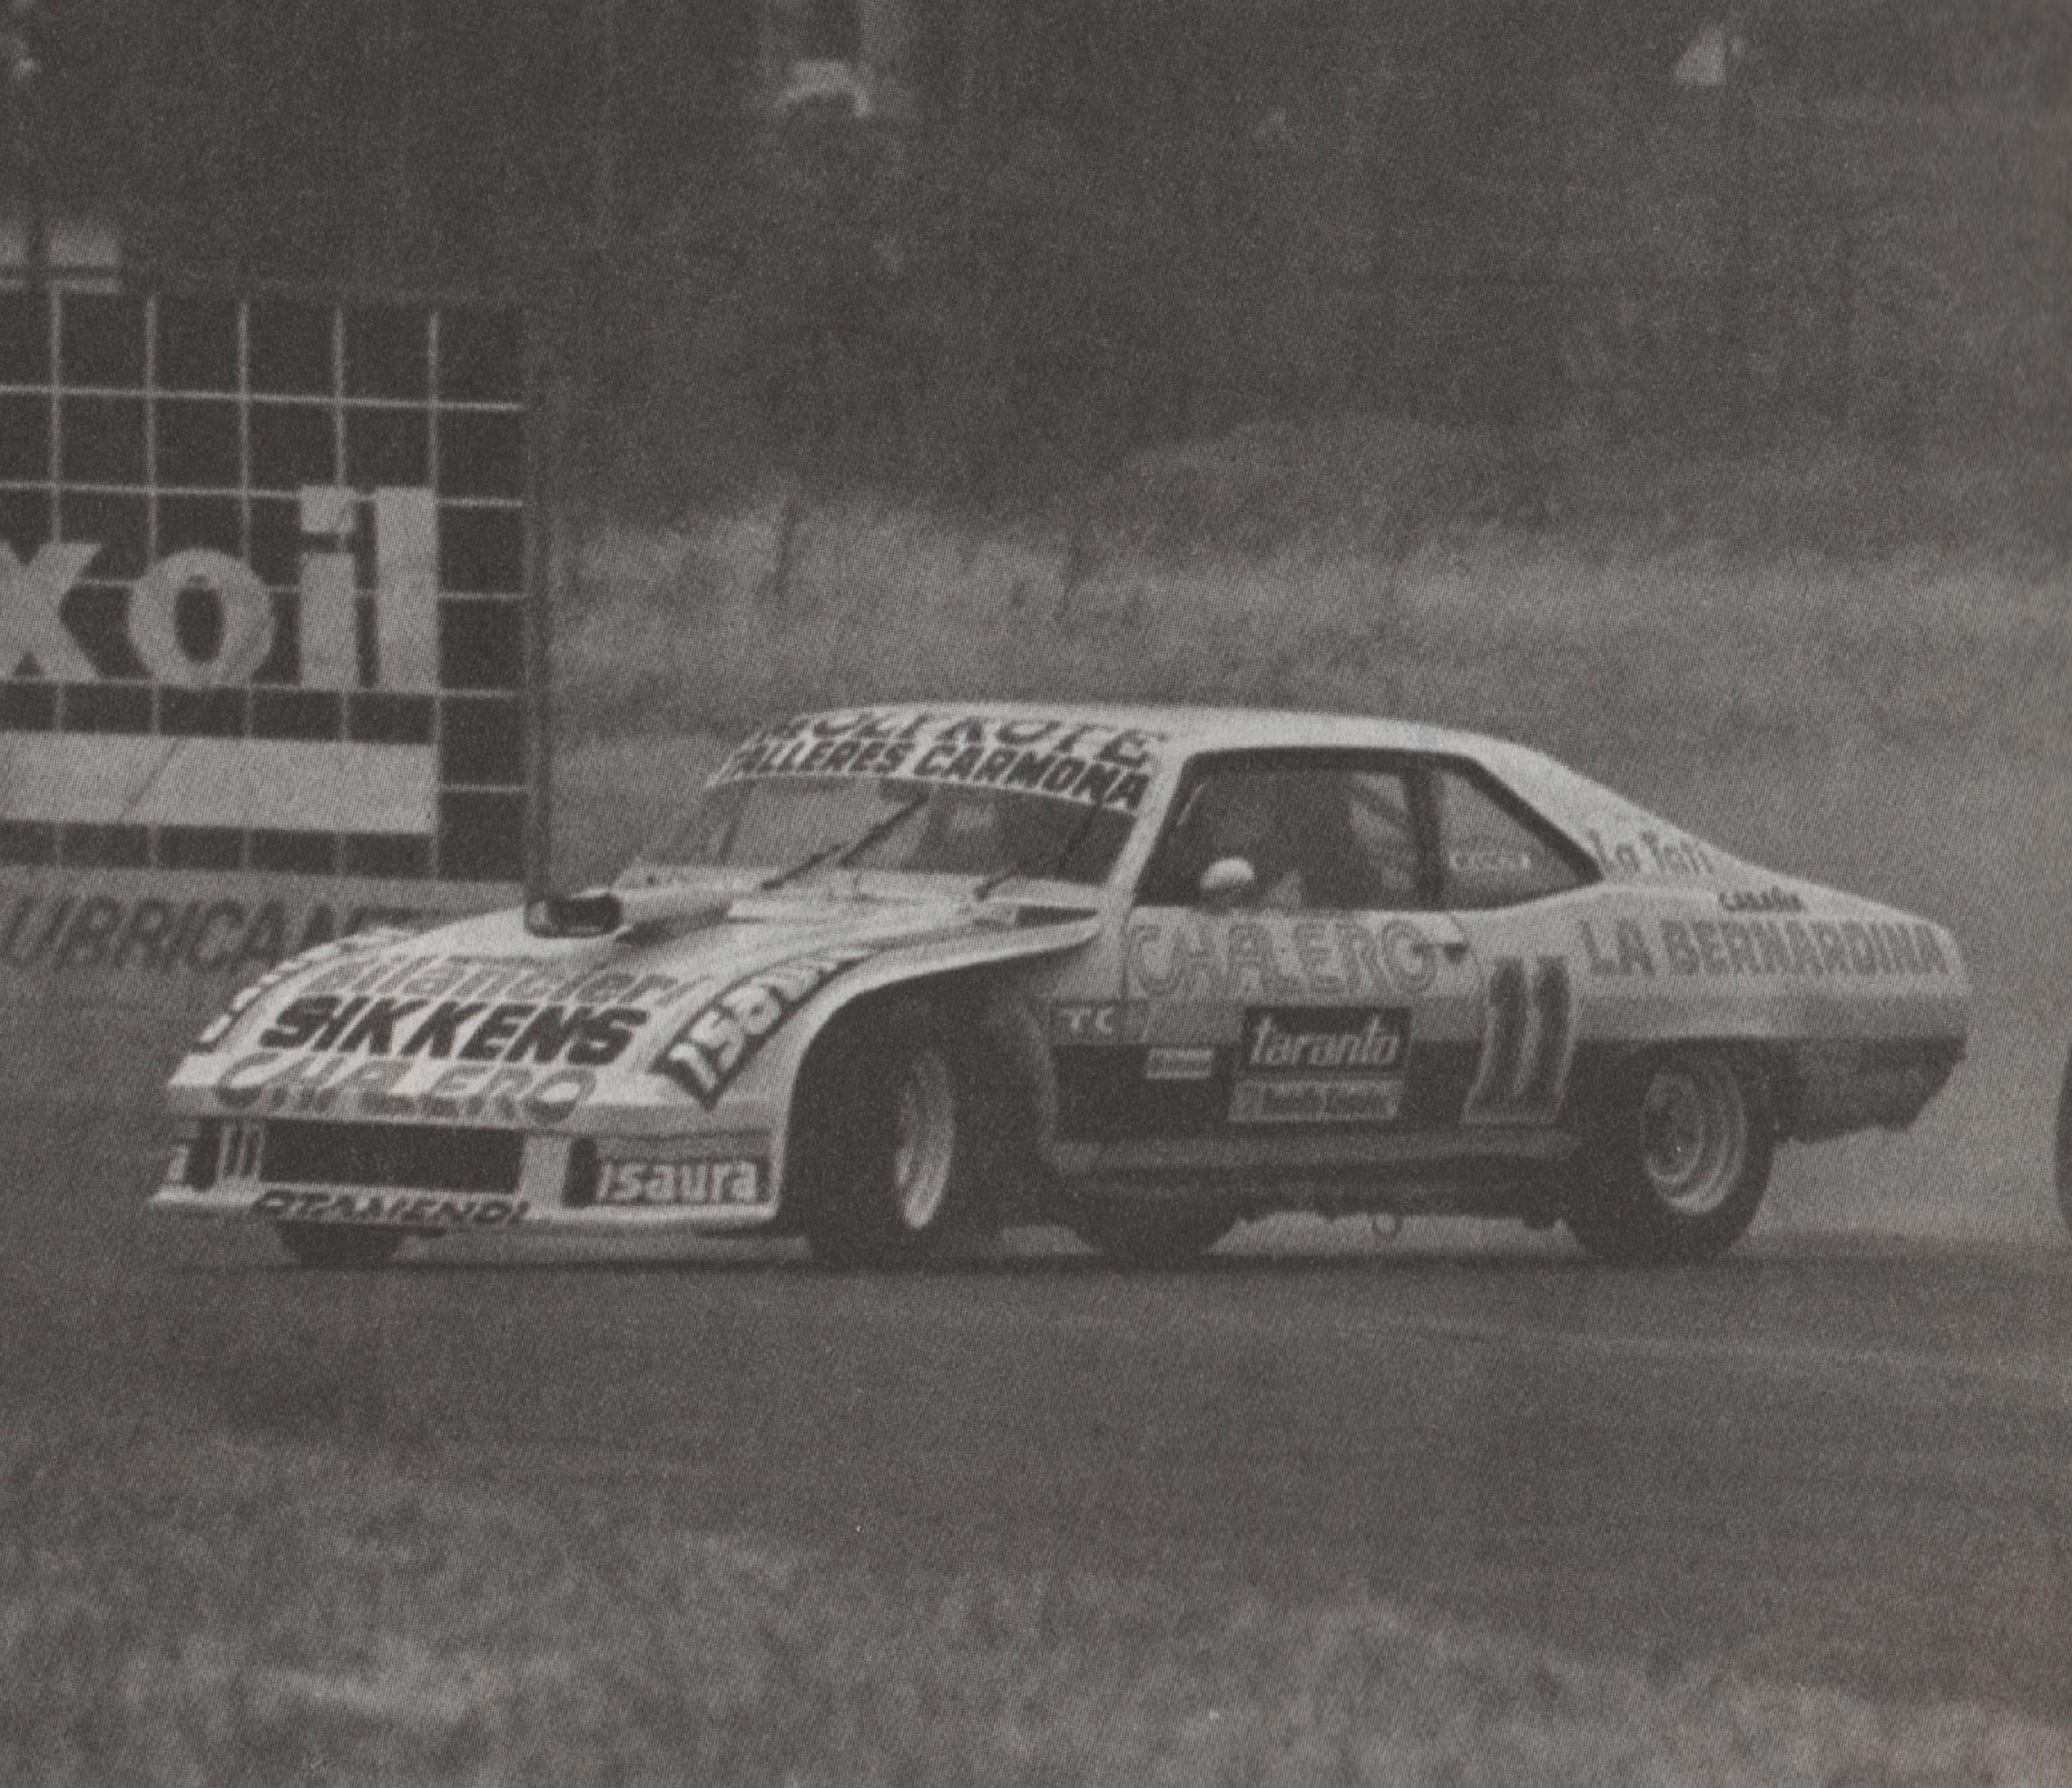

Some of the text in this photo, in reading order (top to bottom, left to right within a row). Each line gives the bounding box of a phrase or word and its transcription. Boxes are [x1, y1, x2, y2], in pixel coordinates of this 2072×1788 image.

[0, 485, 440, 693] xoil
[724, 739, 1151, 813] ALLERES CARMONA
[1579, 918, 1951, 978] LA BERNARDINA
[260, 996, 648, 1066] SIKKENS
[1249, 1014, 1400, 1067] taranto
[1462, 955, 1577, 1124] 11
